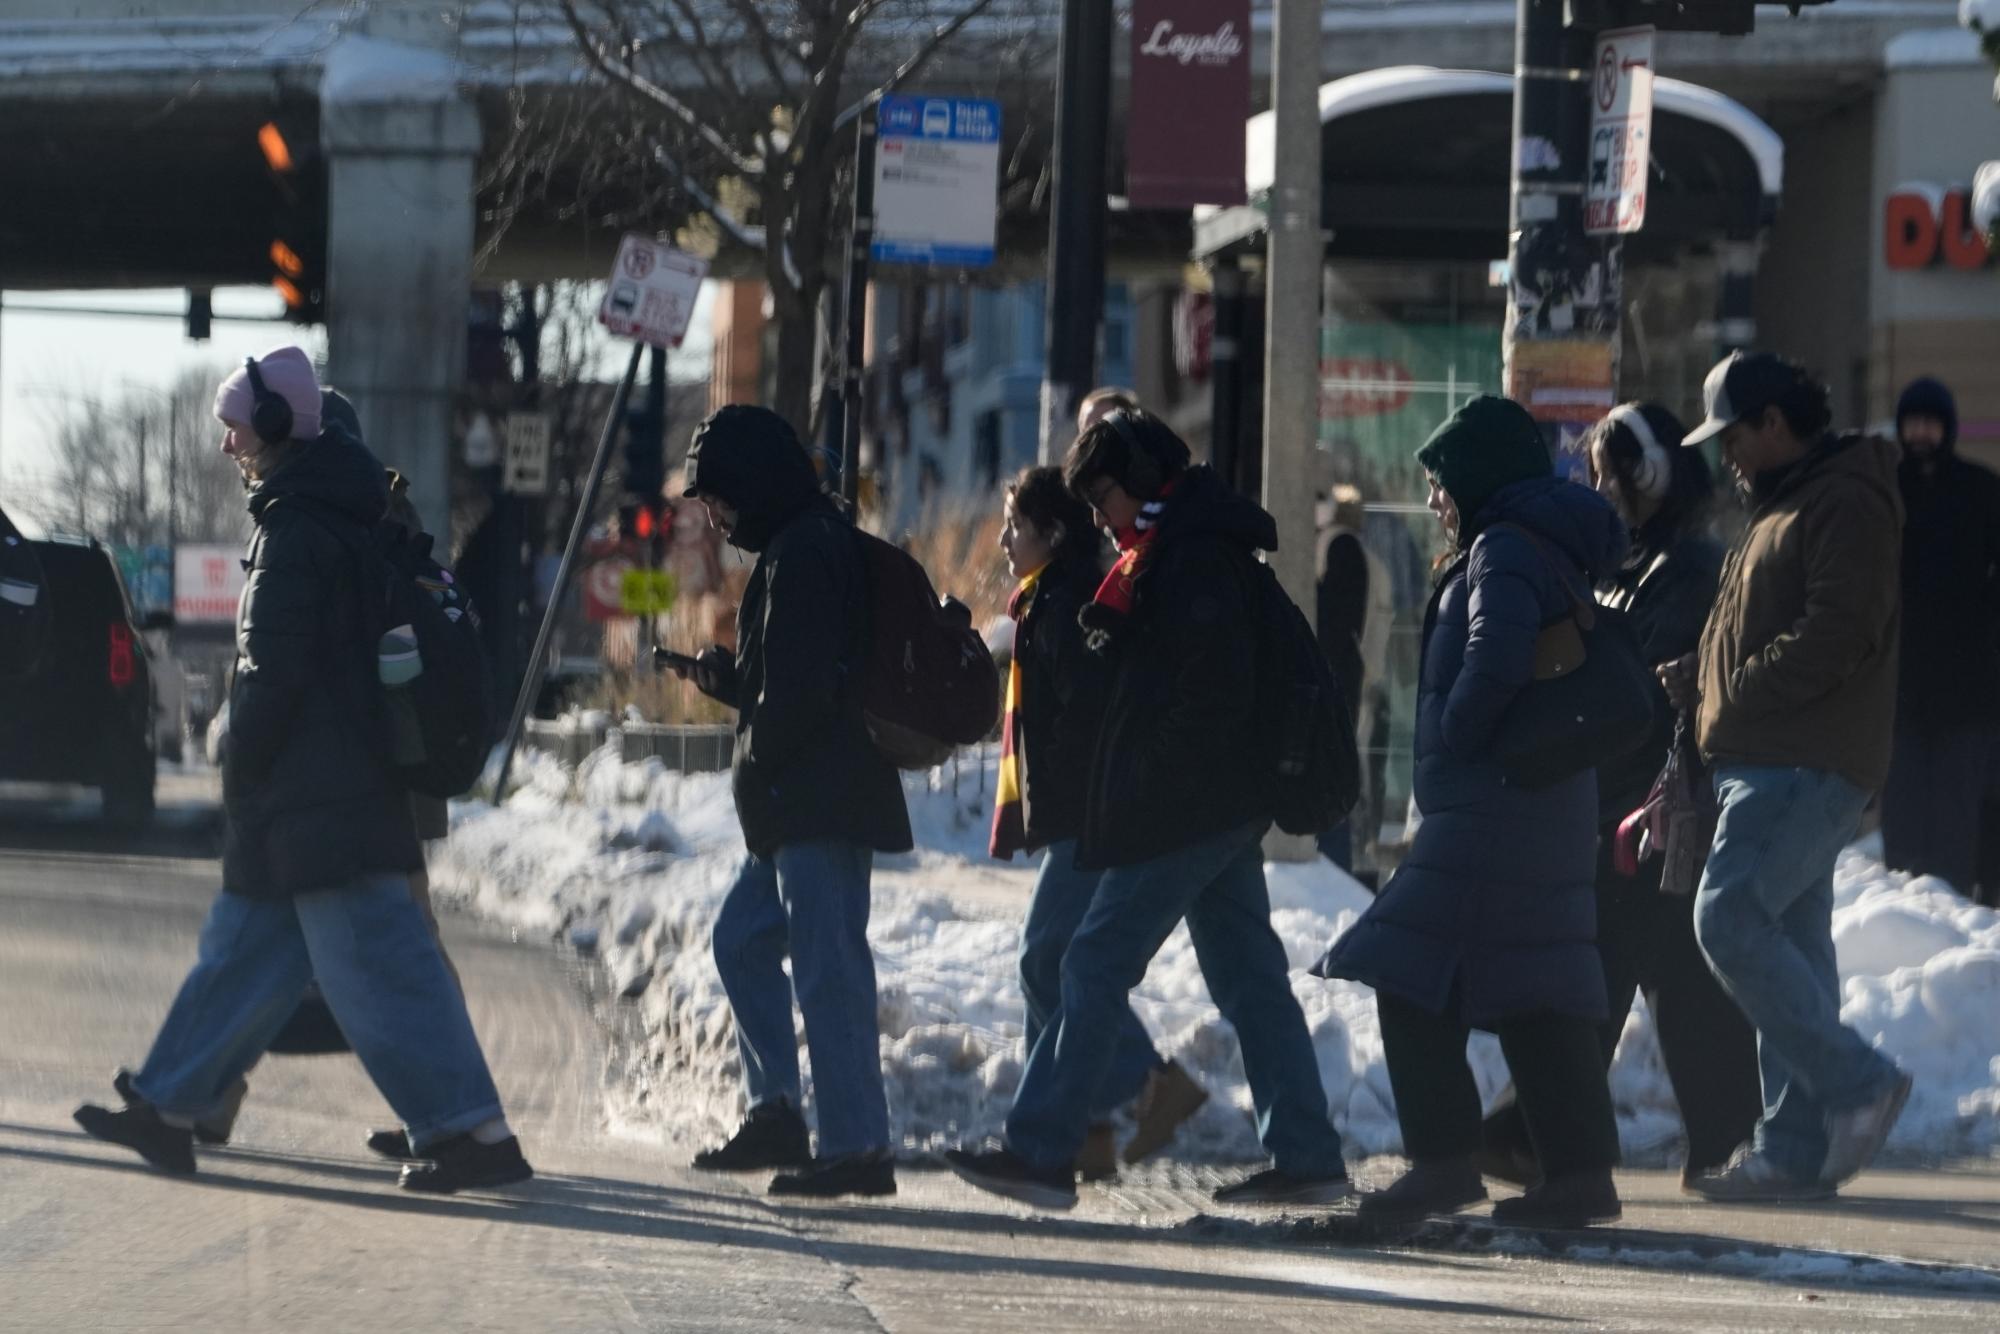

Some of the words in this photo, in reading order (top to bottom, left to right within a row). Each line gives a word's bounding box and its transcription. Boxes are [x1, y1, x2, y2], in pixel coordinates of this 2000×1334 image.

[1141, 20, 1242, 65] Loyola
[956, 101, 988, 119] bus
[956, 119, 993, 139] stop
[1613, 126, 1635, 154] BUS
[1611, 159, 1637, 192] STOP
